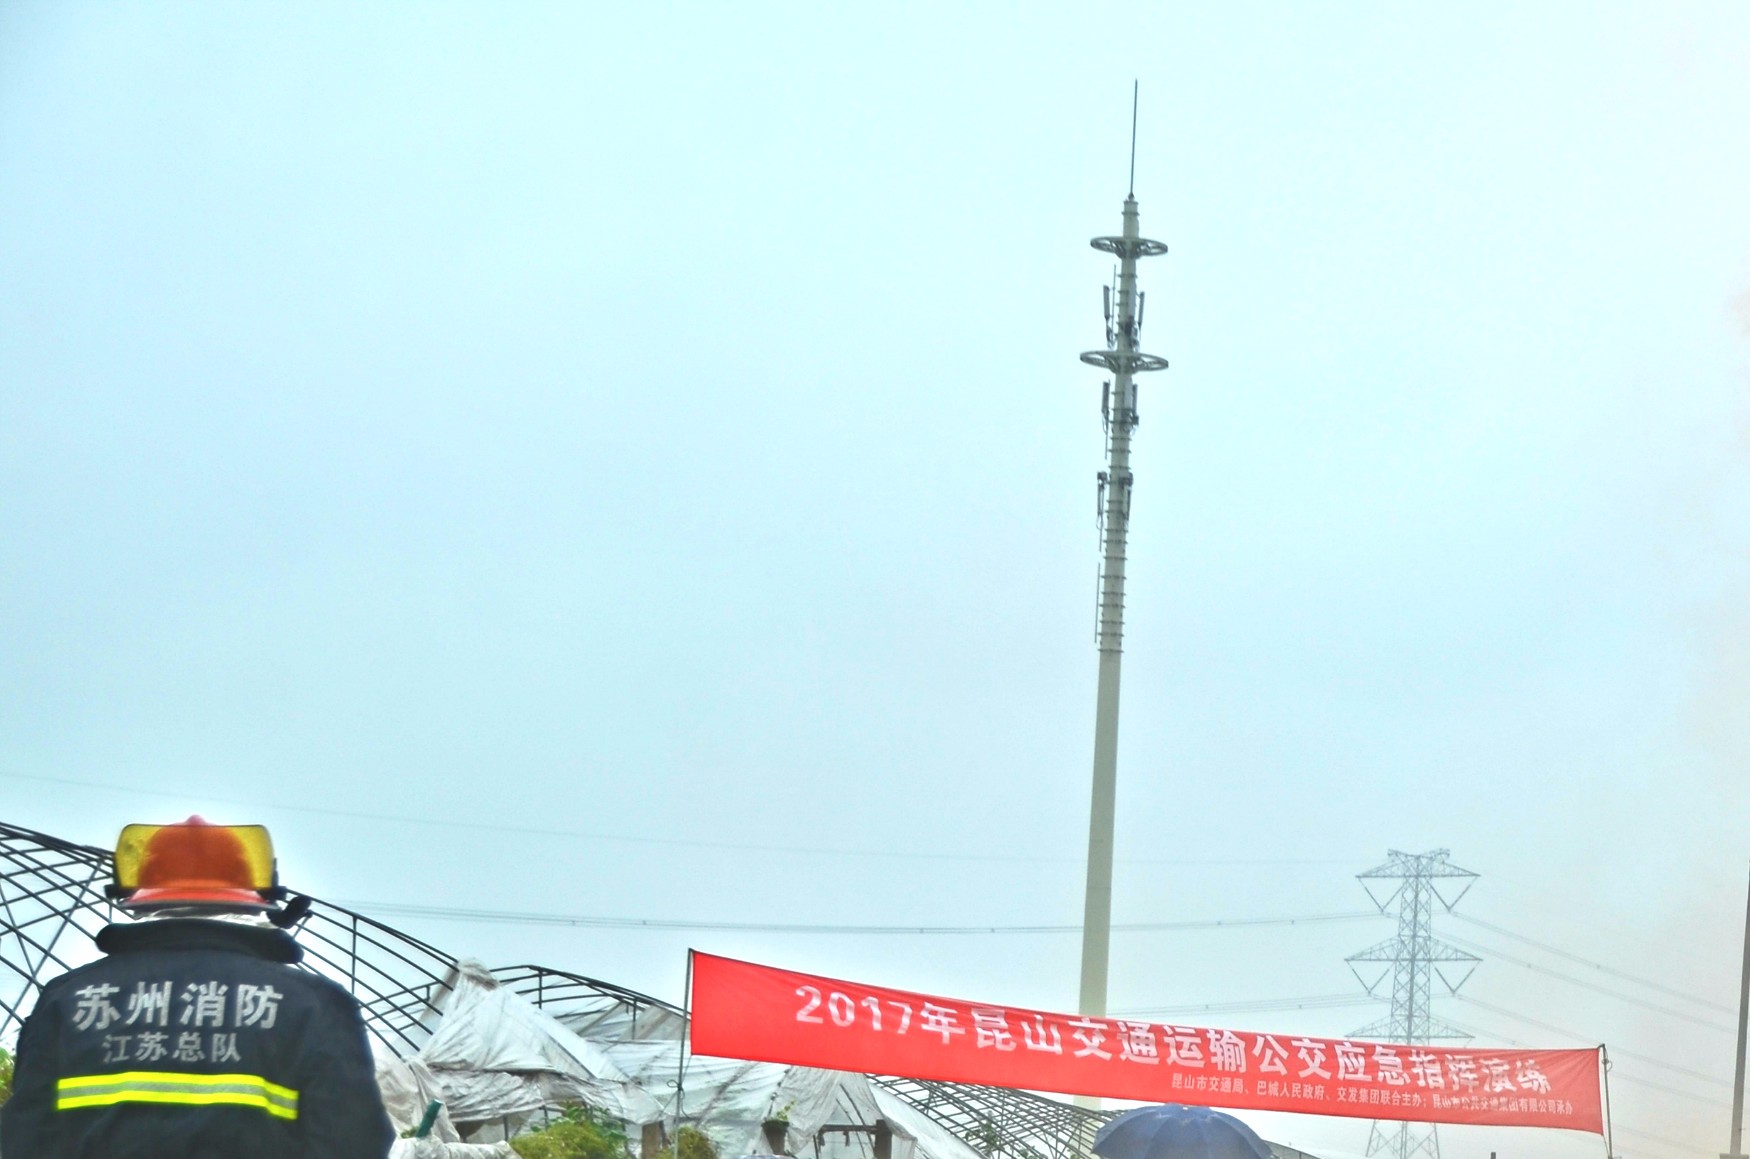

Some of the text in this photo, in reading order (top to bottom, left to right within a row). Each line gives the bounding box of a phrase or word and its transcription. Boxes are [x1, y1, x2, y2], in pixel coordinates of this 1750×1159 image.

[72, 980, 285, 1031] 苏州消防
[101, 1031, 242, 1064] 江苏总队
[795, 984, 1551, 1095] 2017年昆山交通运输公交应急指挥演练
